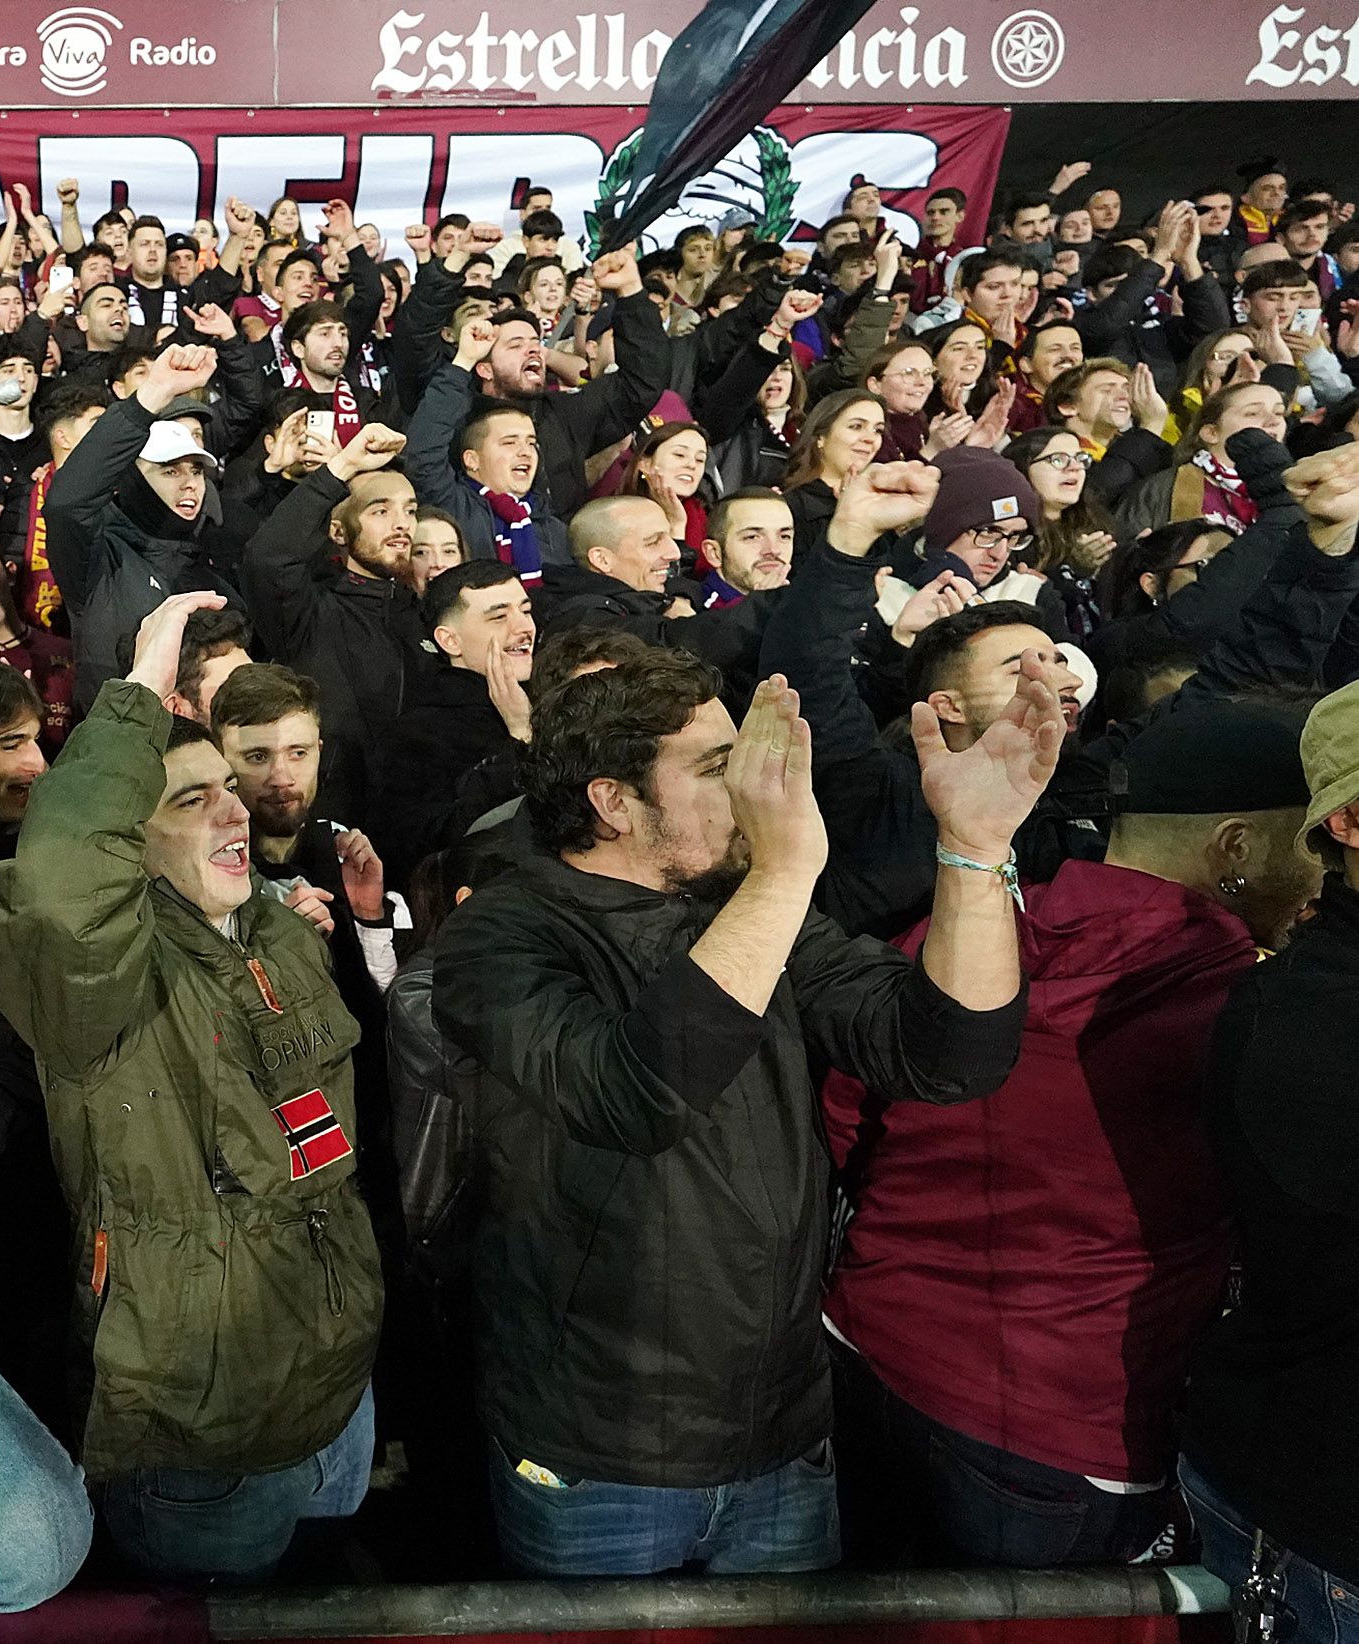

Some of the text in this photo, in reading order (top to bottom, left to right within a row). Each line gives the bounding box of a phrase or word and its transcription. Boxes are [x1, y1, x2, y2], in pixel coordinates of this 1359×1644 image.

[48, 38, 101, 65] Viva
[129, 38, 217, 66] Radio
[261, 1019, 337, 1072] ORWAY
